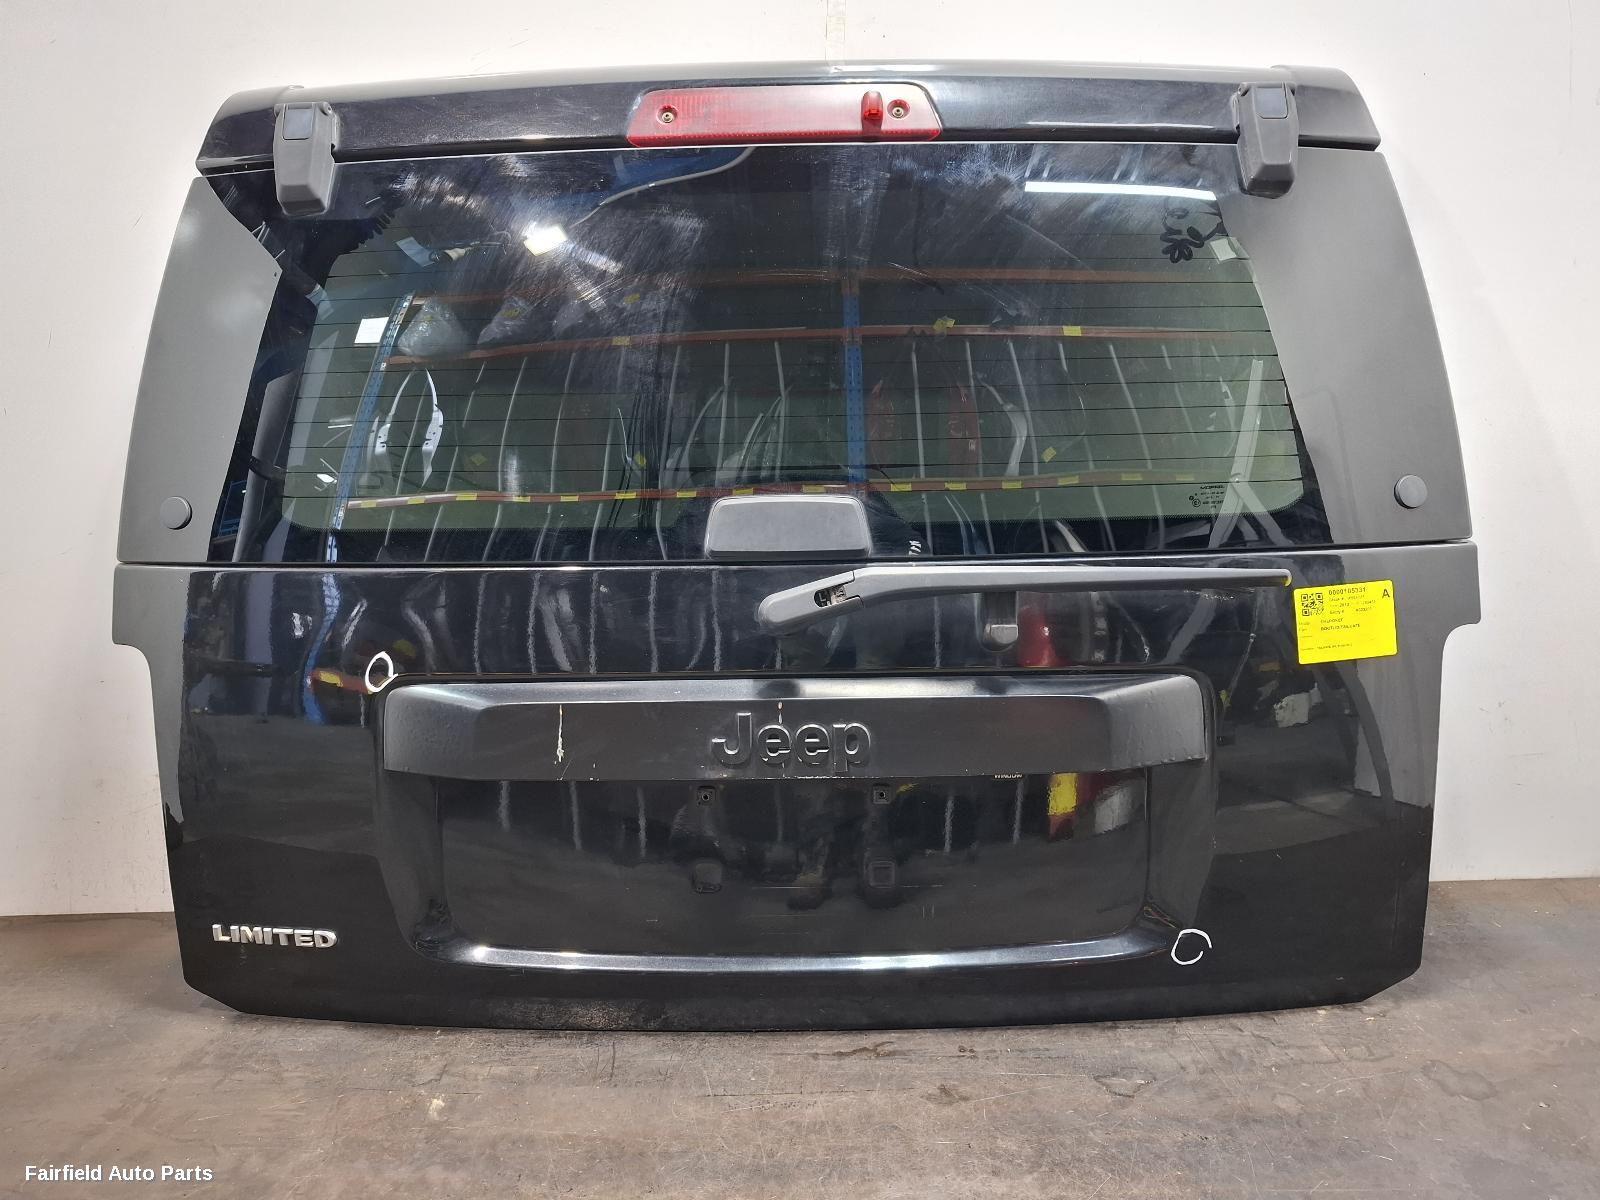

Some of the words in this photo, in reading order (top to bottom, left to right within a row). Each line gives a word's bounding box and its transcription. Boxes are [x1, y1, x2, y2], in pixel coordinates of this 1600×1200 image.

[1381, 588, 1390, 598] A
[711, 712, 872, 772] Jeep
[212, 924, 338, 948] LIMITED
